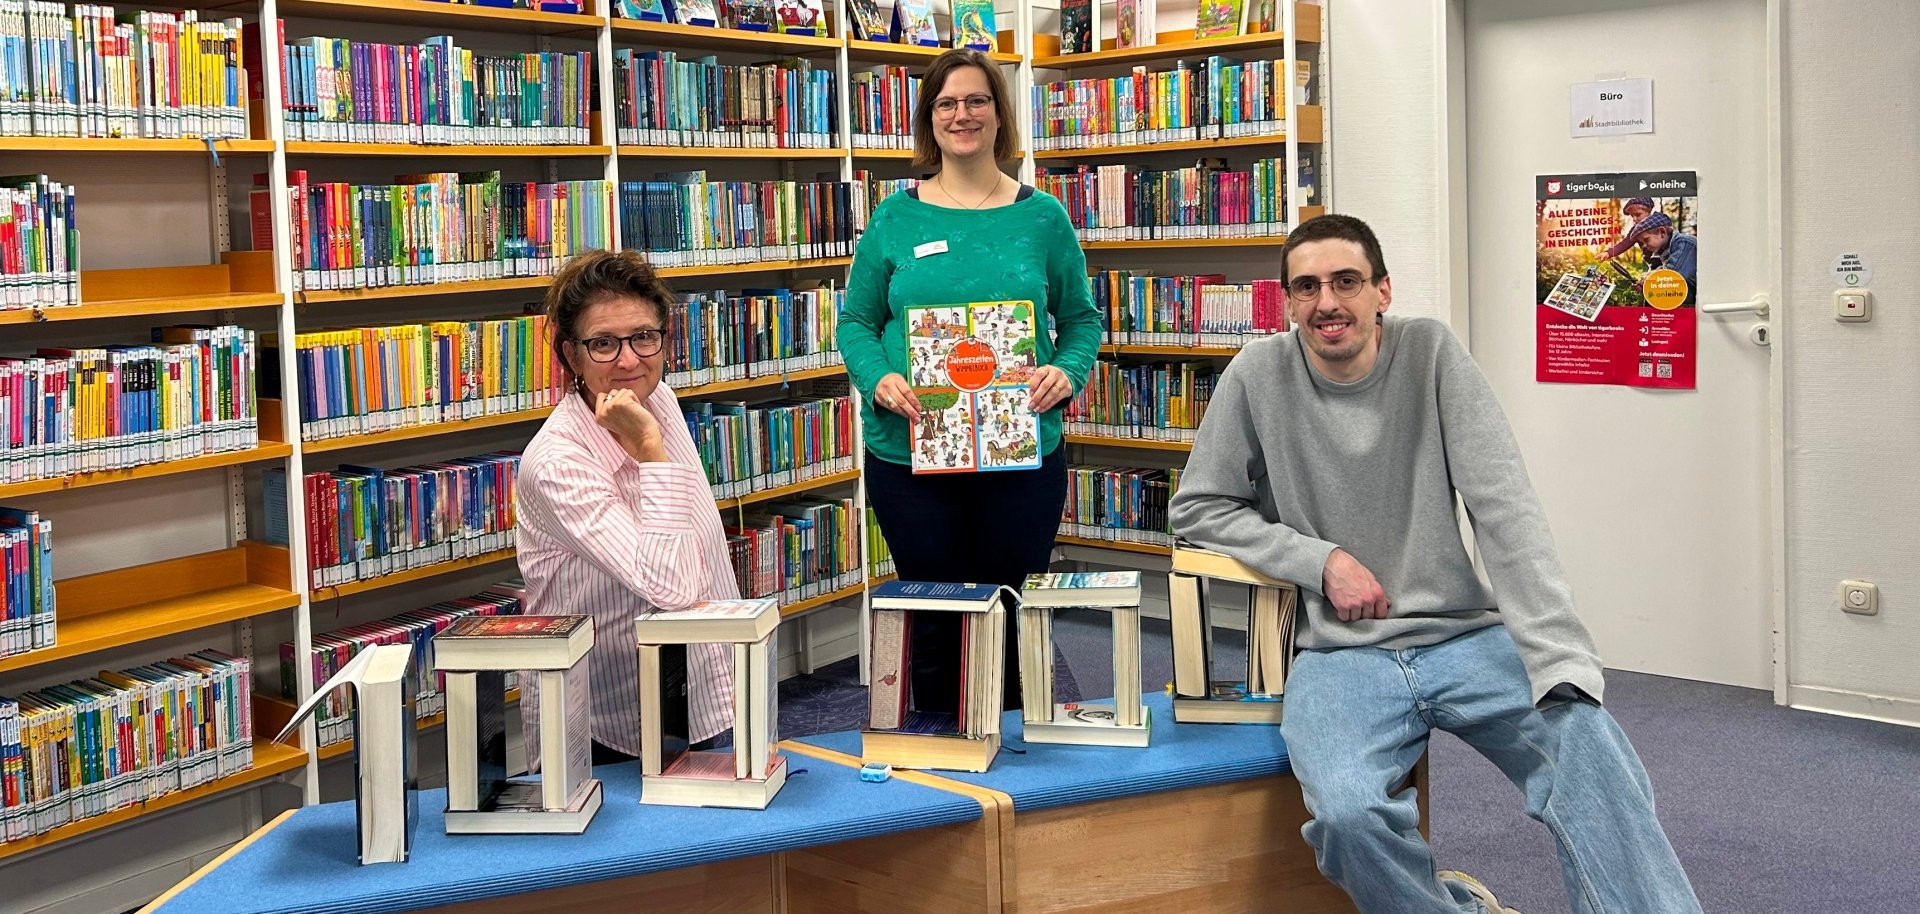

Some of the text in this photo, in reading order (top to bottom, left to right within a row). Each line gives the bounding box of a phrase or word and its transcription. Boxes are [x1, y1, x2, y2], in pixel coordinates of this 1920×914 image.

[1600, 92, 1623, 101] Büro
[1566, 182, 1615, 193] tigerbooks
[1650, 180, 1687, 189] onleihe
[1548, 208, 1607, 218] ALLE DEINE
[1548, 226, 1622, 238] GESCHICHTEN
[1558, 239, 1588, 247] EINER
[1590, 238, 1612, 246] APP
[949, 354, 994, 364] Jahreszeiten
